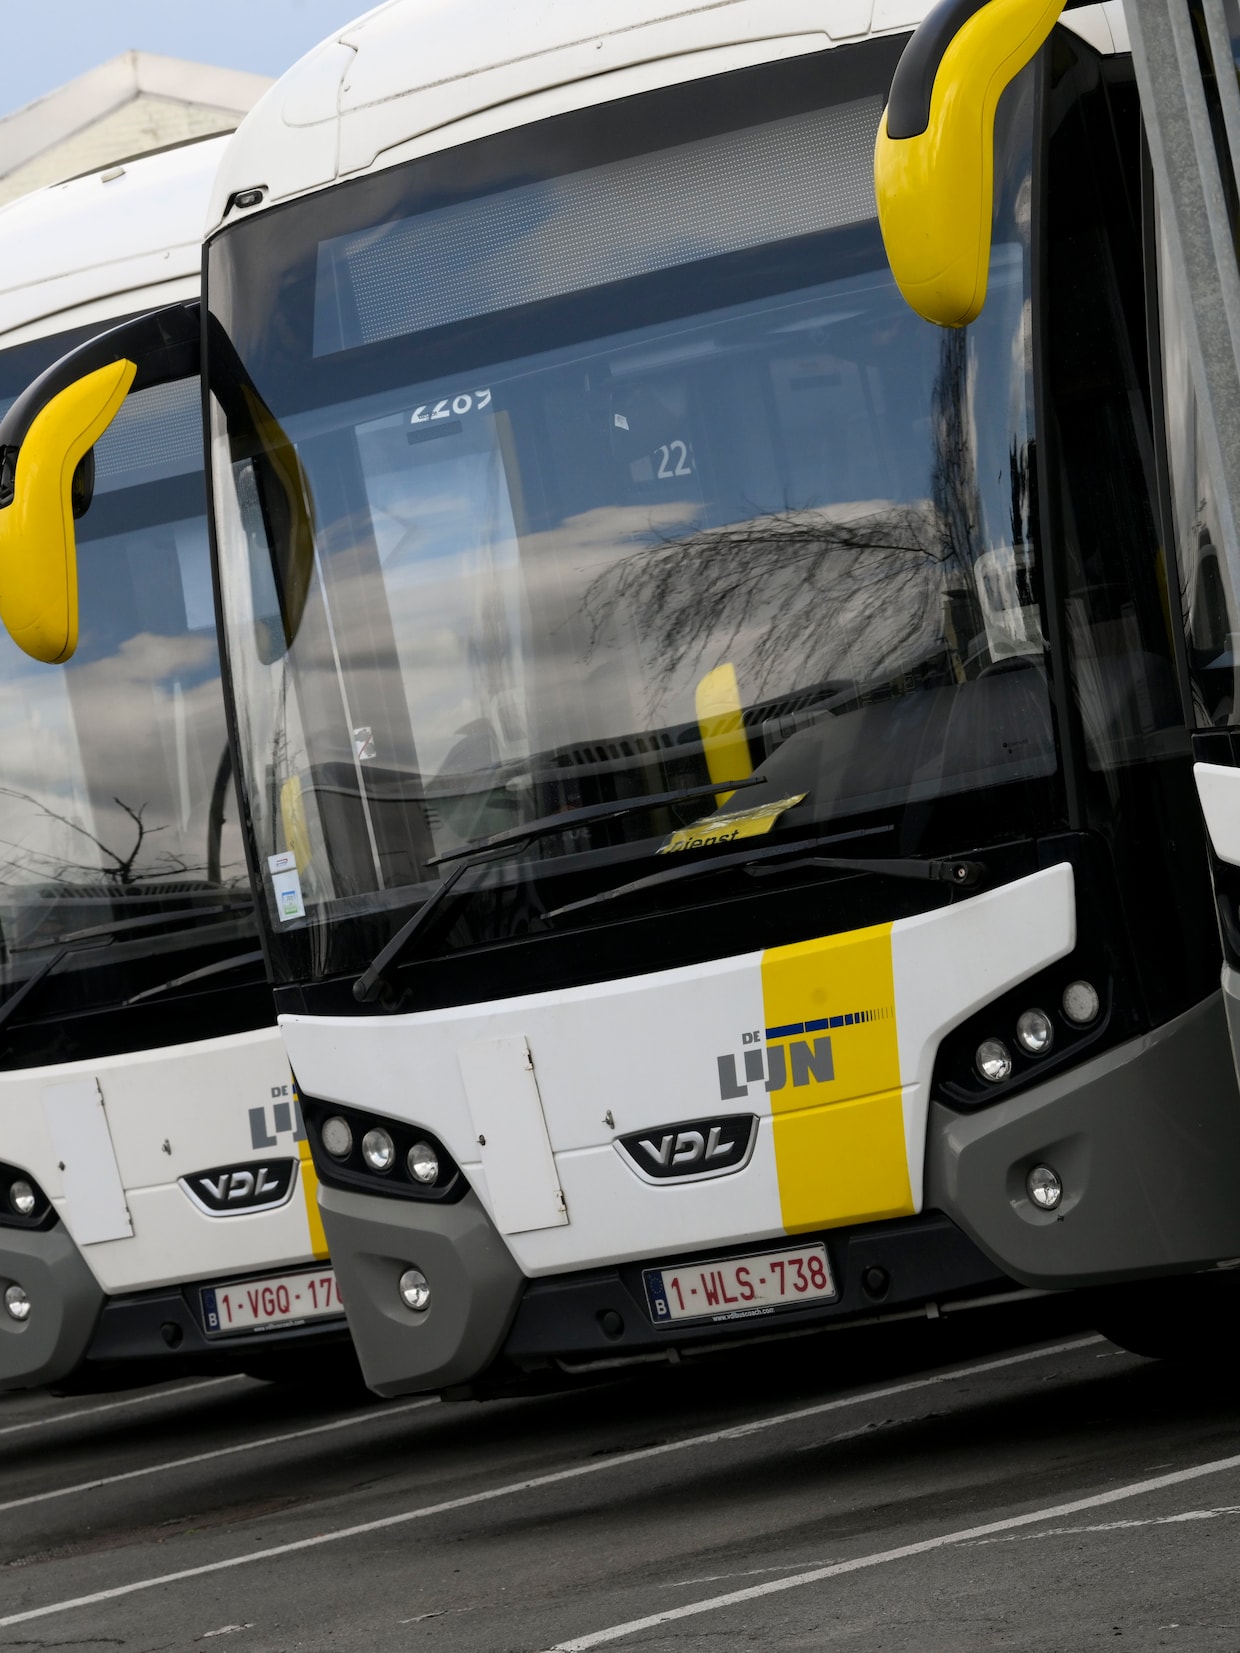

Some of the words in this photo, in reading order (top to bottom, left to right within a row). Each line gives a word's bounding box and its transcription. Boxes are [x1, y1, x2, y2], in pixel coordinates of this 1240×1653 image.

[653, 440, 694, 479] 22
[742, 1030, 761, 1045] DE
[717, 1036, 835, 1101] LIJN
[271, 1085, 289, 1099] DE
[248, 1100, 309, 1150] LIJ
[638, 1126, 735, 1166] VDL
[200, 1167, 279, 1200] VDL
[209, 1312, 218, 1327] B
[656, 1299, 668, 1316] B
